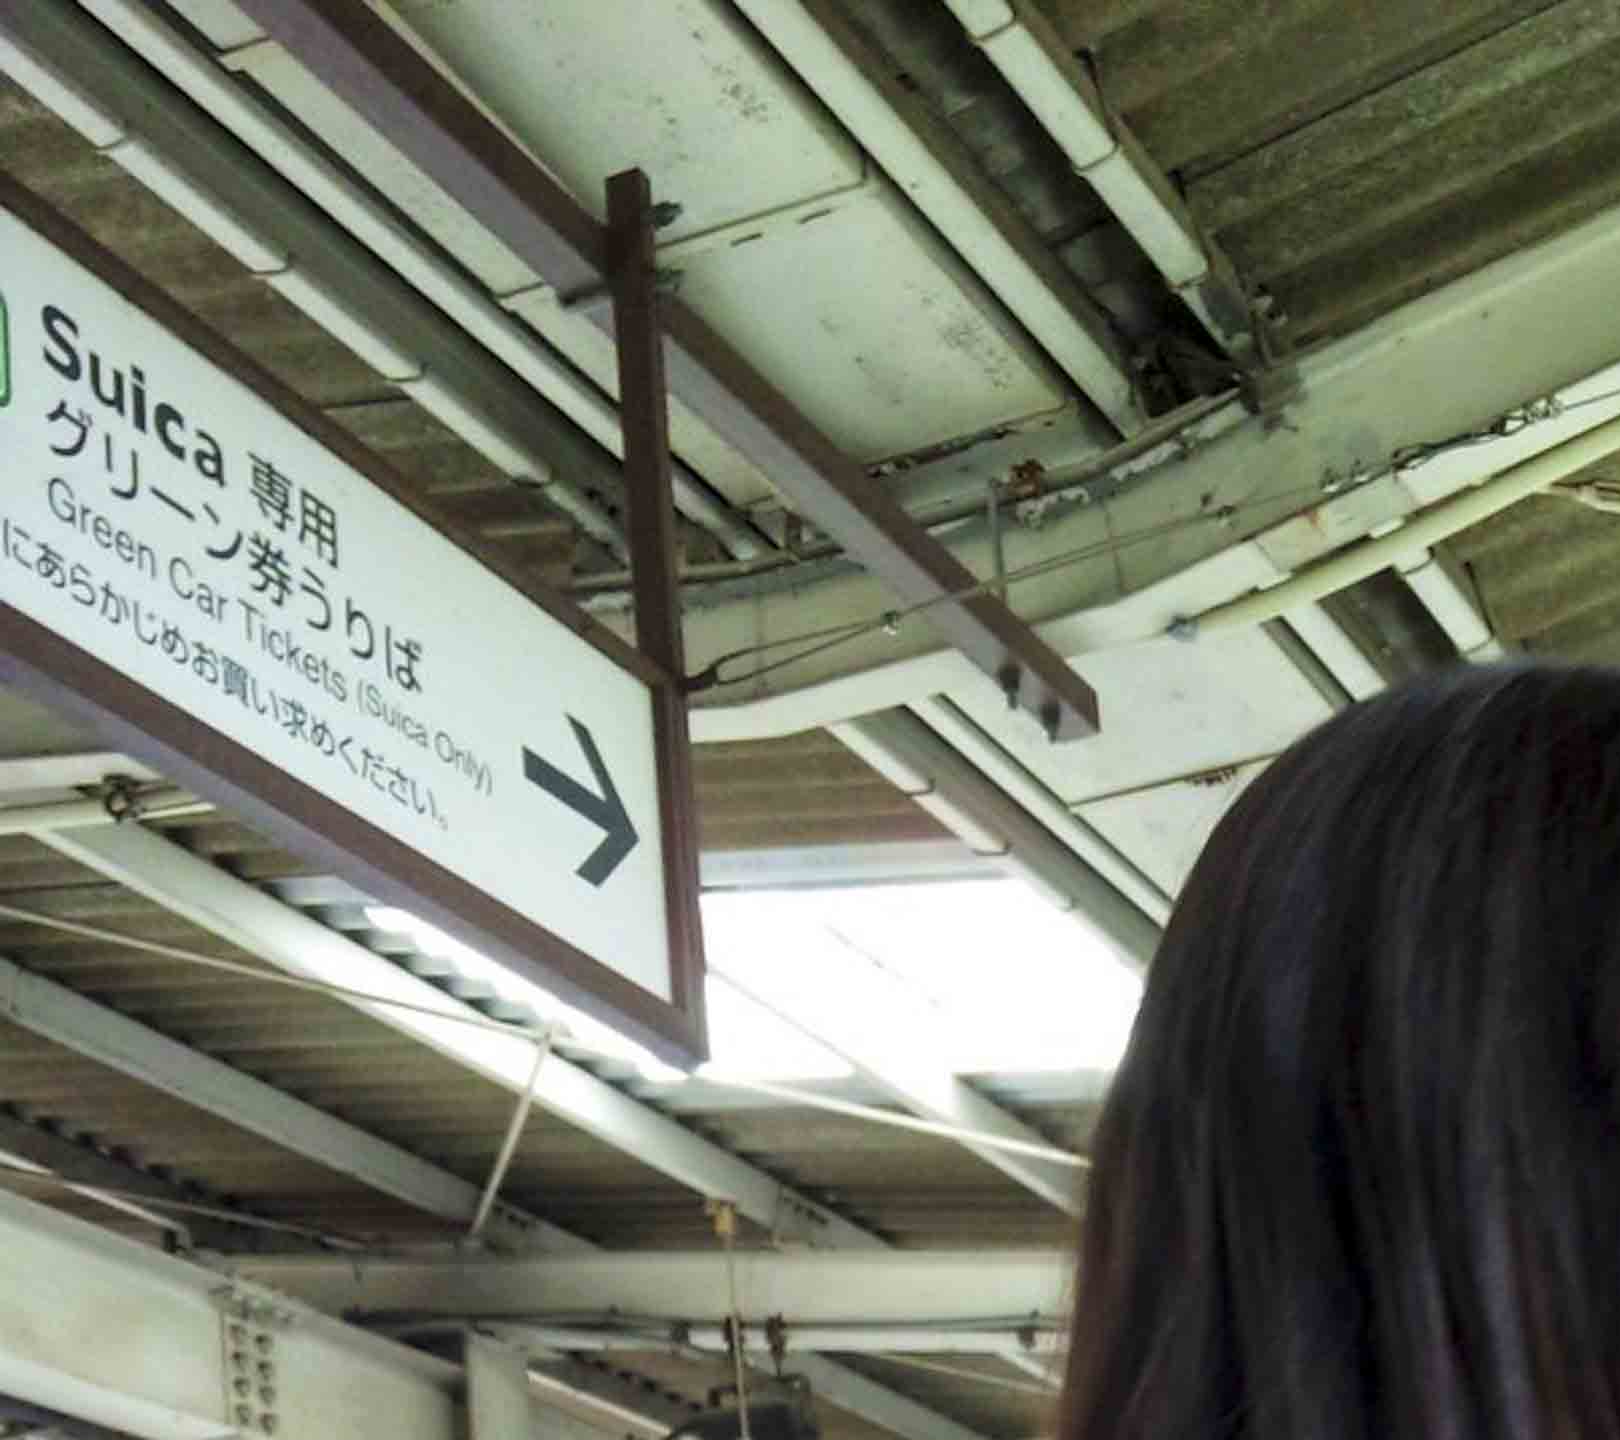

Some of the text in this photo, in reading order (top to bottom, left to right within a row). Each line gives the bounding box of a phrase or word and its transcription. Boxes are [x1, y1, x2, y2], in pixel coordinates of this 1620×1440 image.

[42, 304, 339, 569] Suica 専用
[46, 400, 423, 693] グリーン券うりば
[2, 517, 449, 831] にあらかじめお買い求めください。
[49, 477, 494, 797] Green Car Tickets (Suica Only)
